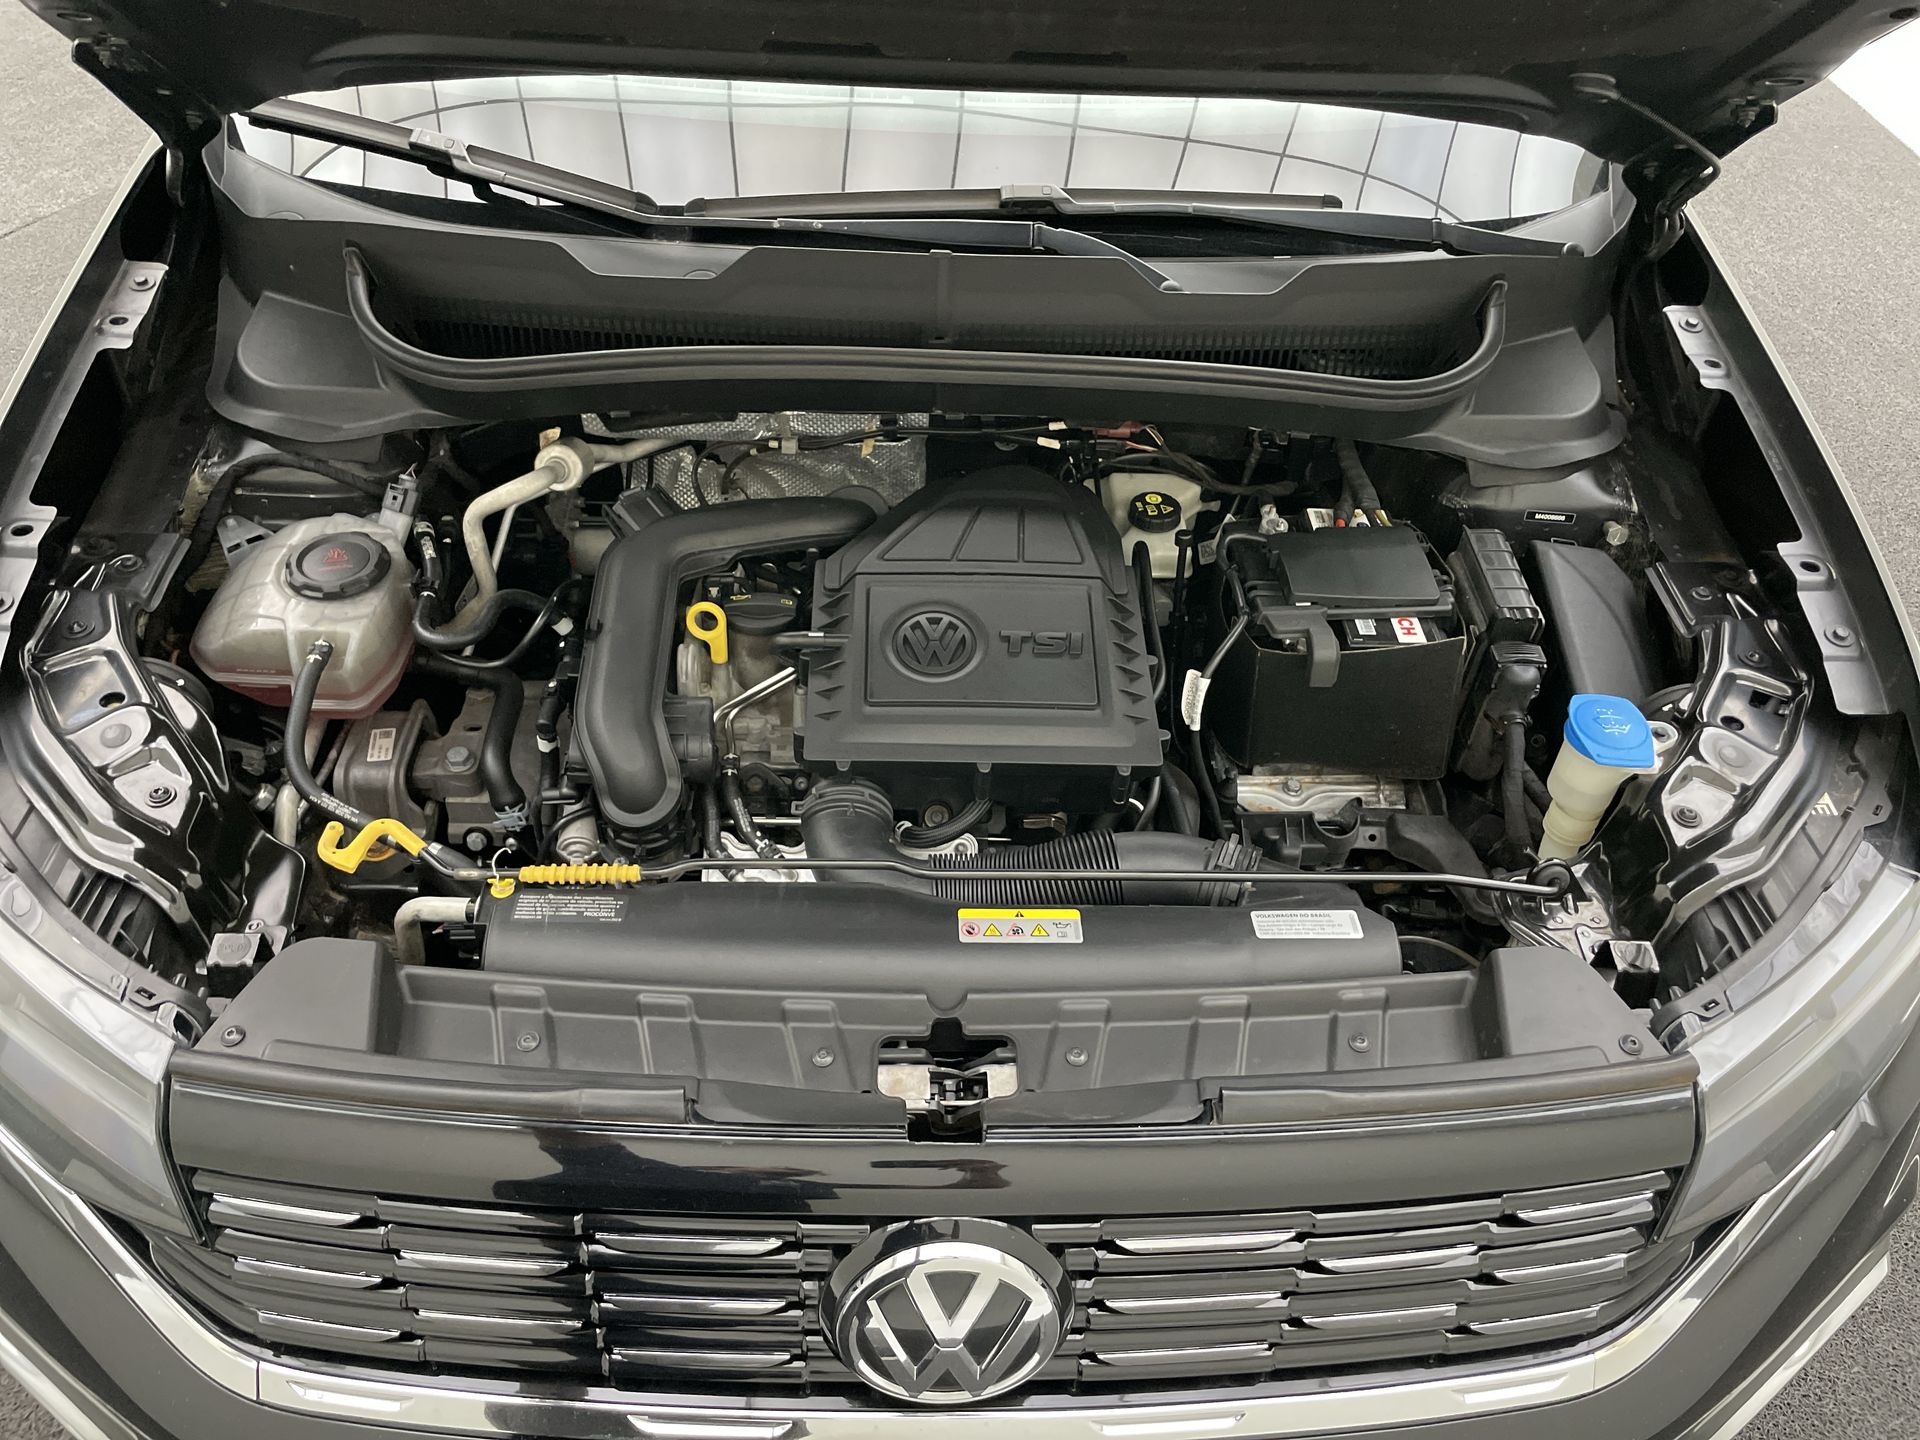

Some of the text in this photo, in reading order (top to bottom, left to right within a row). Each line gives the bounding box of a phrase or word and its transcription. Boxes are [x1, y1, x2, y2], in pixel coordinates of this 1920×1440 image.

[893, 611, 1084, 674] VW TSI
[845, 1250, 1056, 1402] VW
